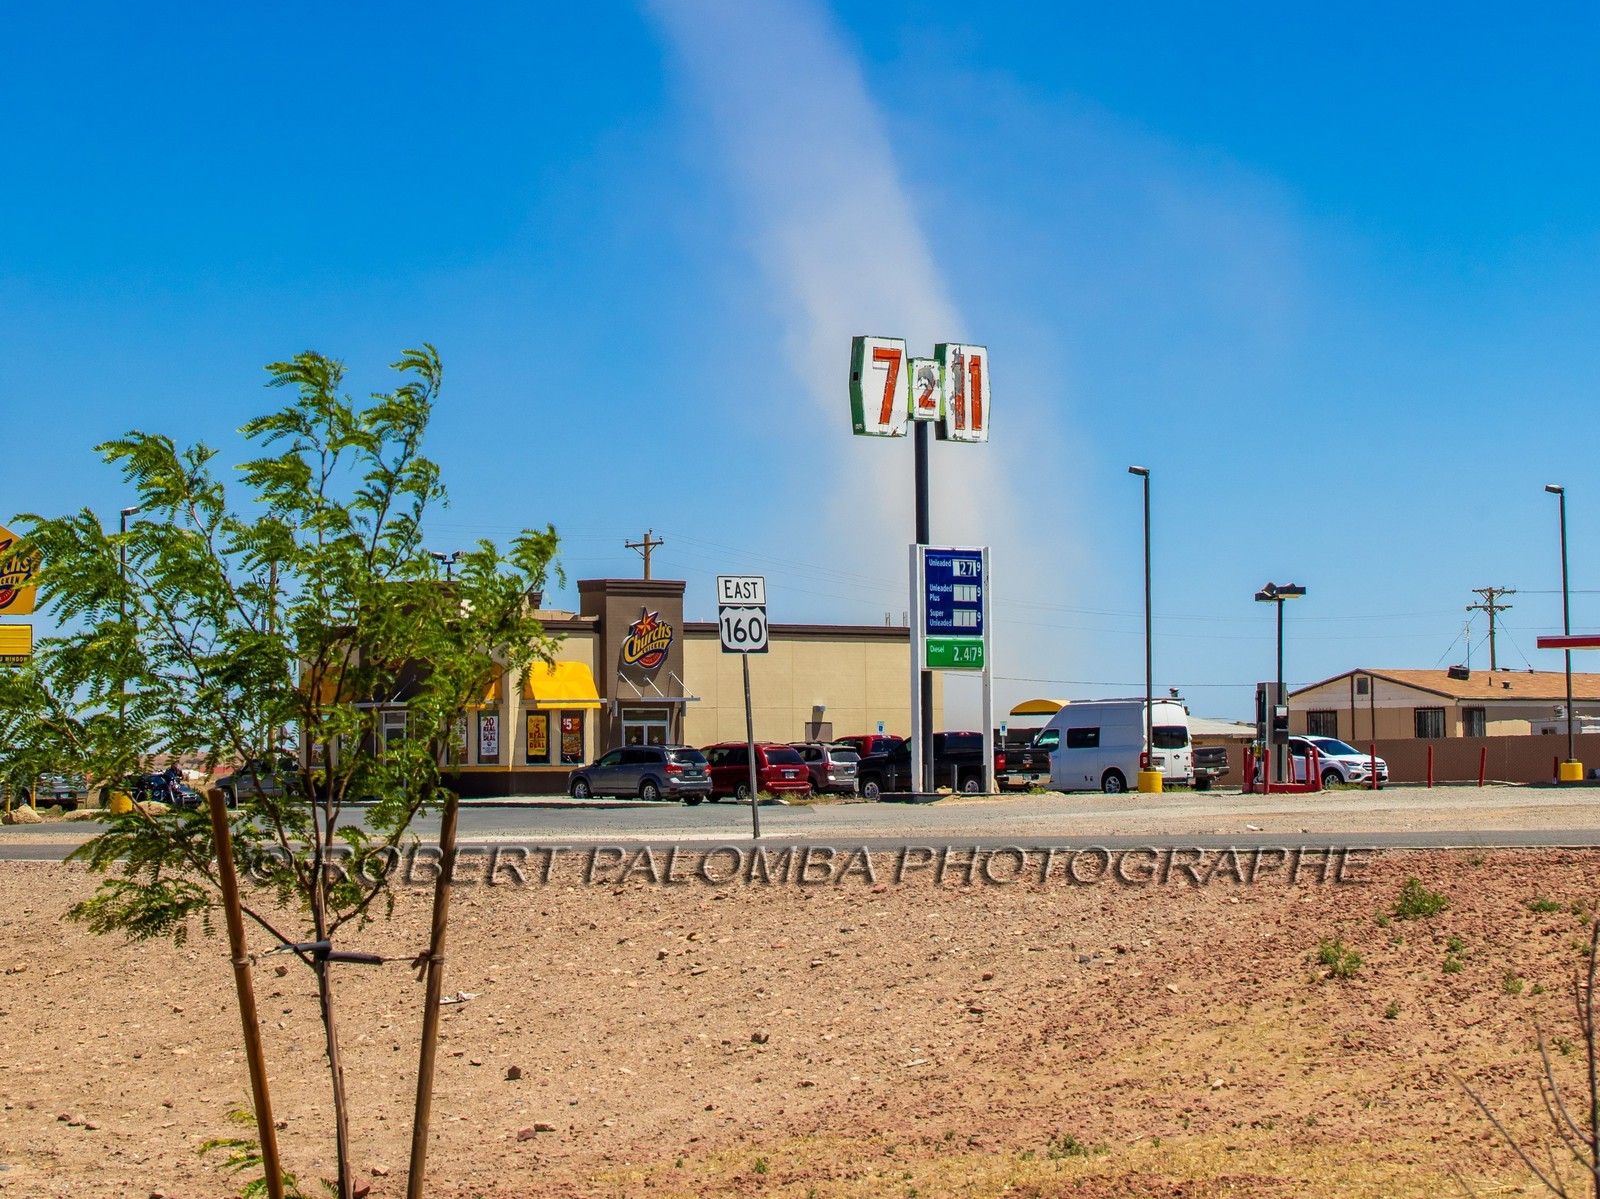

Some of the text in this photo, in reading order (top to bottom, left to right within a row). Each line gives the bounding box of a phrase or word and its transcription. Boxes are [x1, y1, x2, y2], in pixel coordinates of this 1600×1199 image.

[928, 559, 952, 567] Unleaded
[724, 579, 758, 599] EAST
[929, 584, 953, 593] Unleaded
[929, 593, 940, 602] Plus
[929, 608, 944, 618] Super
[929, 618, 953, 627] Unleaded
[724, 616, 763, 643] 160
[624, 622, 672, 663] Church's
[929, 644, 945, 653] Diesel
